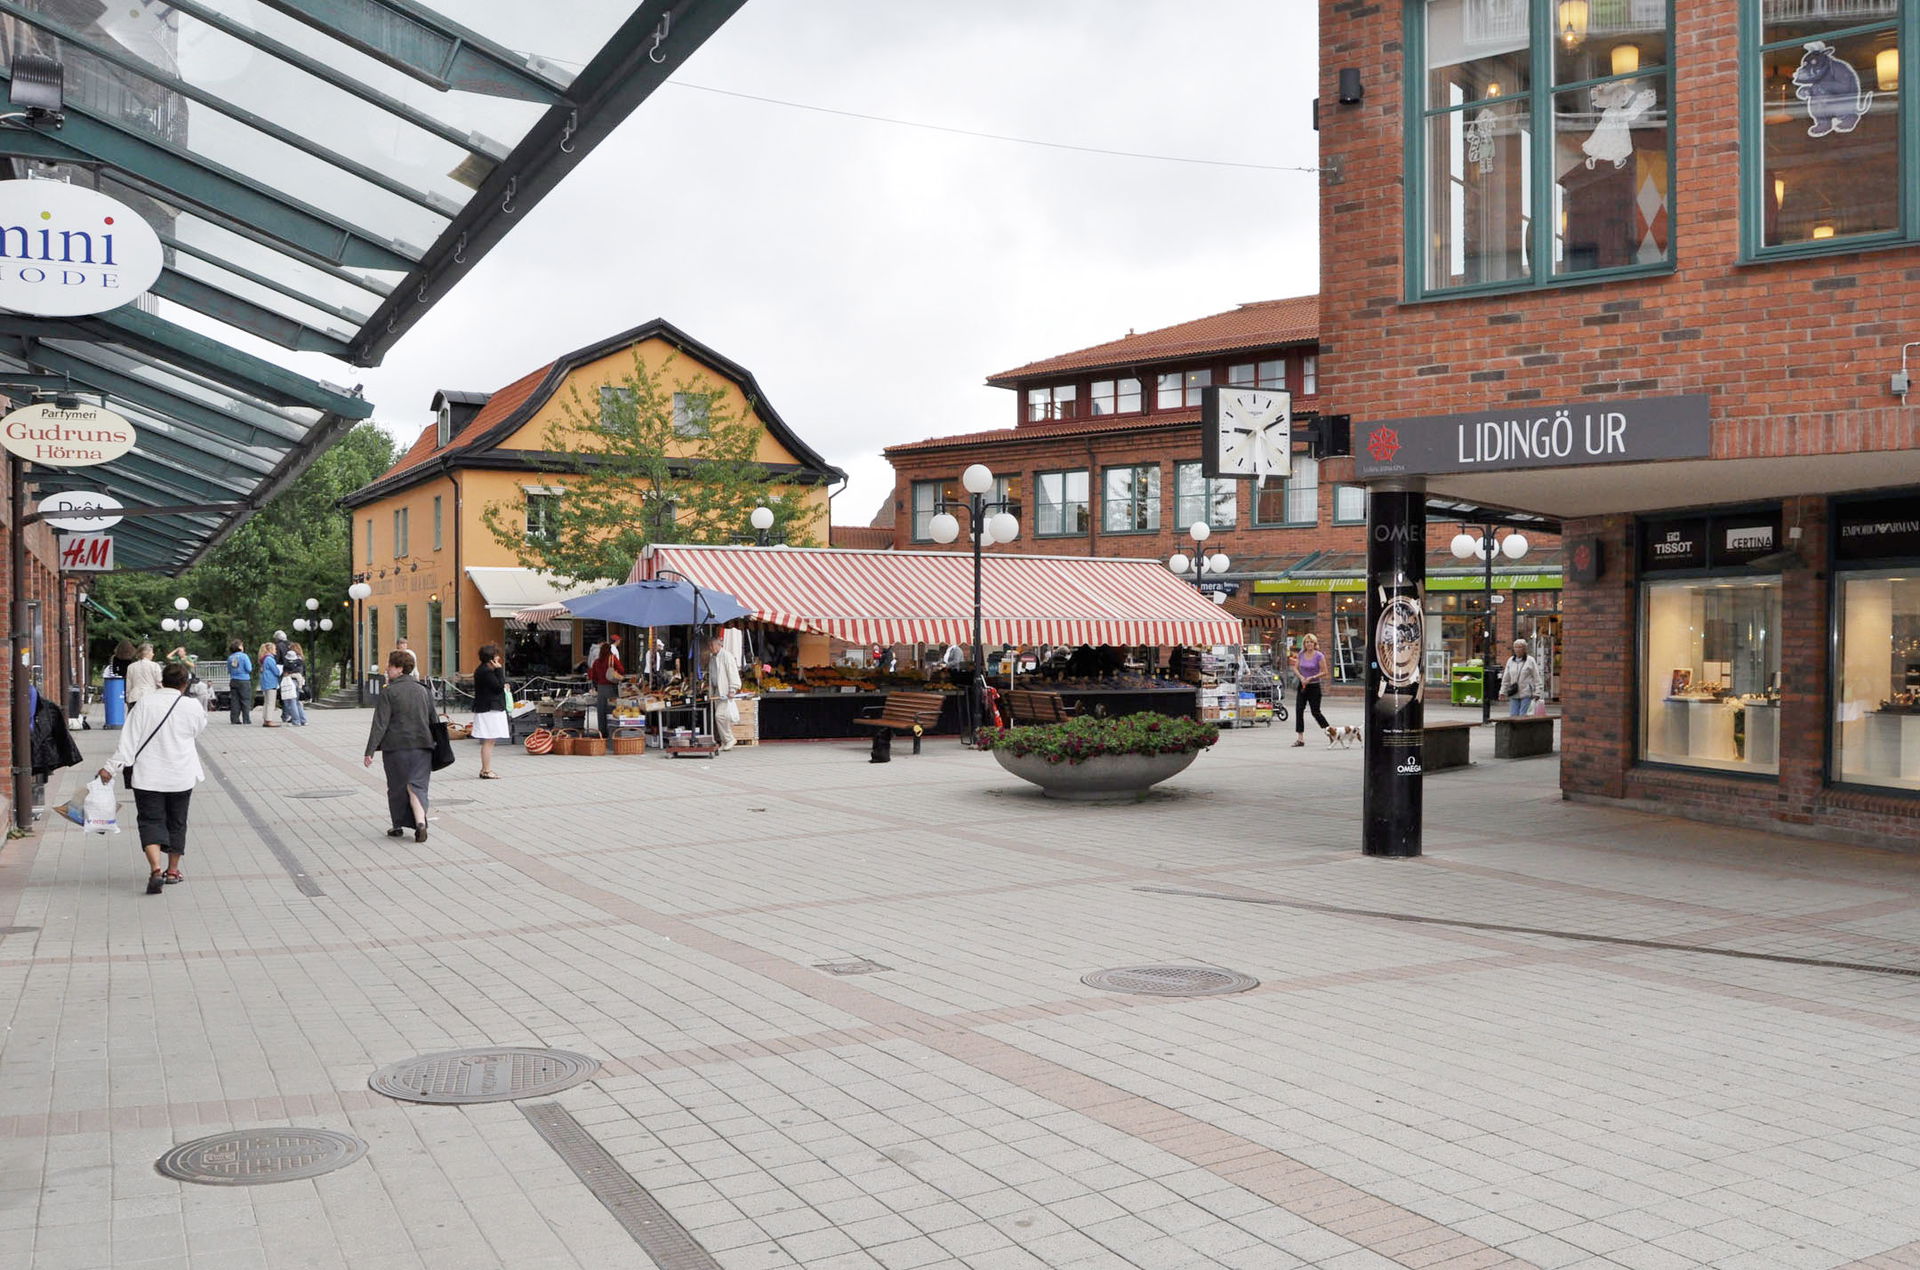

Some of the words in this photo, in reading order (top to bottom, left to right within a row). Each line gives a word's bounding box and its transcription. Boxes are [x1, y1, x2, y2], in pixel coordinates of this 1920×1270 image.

[0, 211, 118, 265] mini
[0, 264, 120, 289] ODE
[41, 408, 97, 421] Parfymeri
[6, 422, 127, 443] Gudruns
[1458, 409, 1573, 463] LIDINGÖ
[1585, 412, 1627, 454] UR
[36, 444, 102, 460] Hörna
[1375, 524, 1425, 542] OME
[1654, 541, 1693, 554] TISSOT
[1732, 535, 1772, 550] CERTINA
[63, 538, 110, 567] H&M
[1397, 765, 1422, 773] OMEGA
